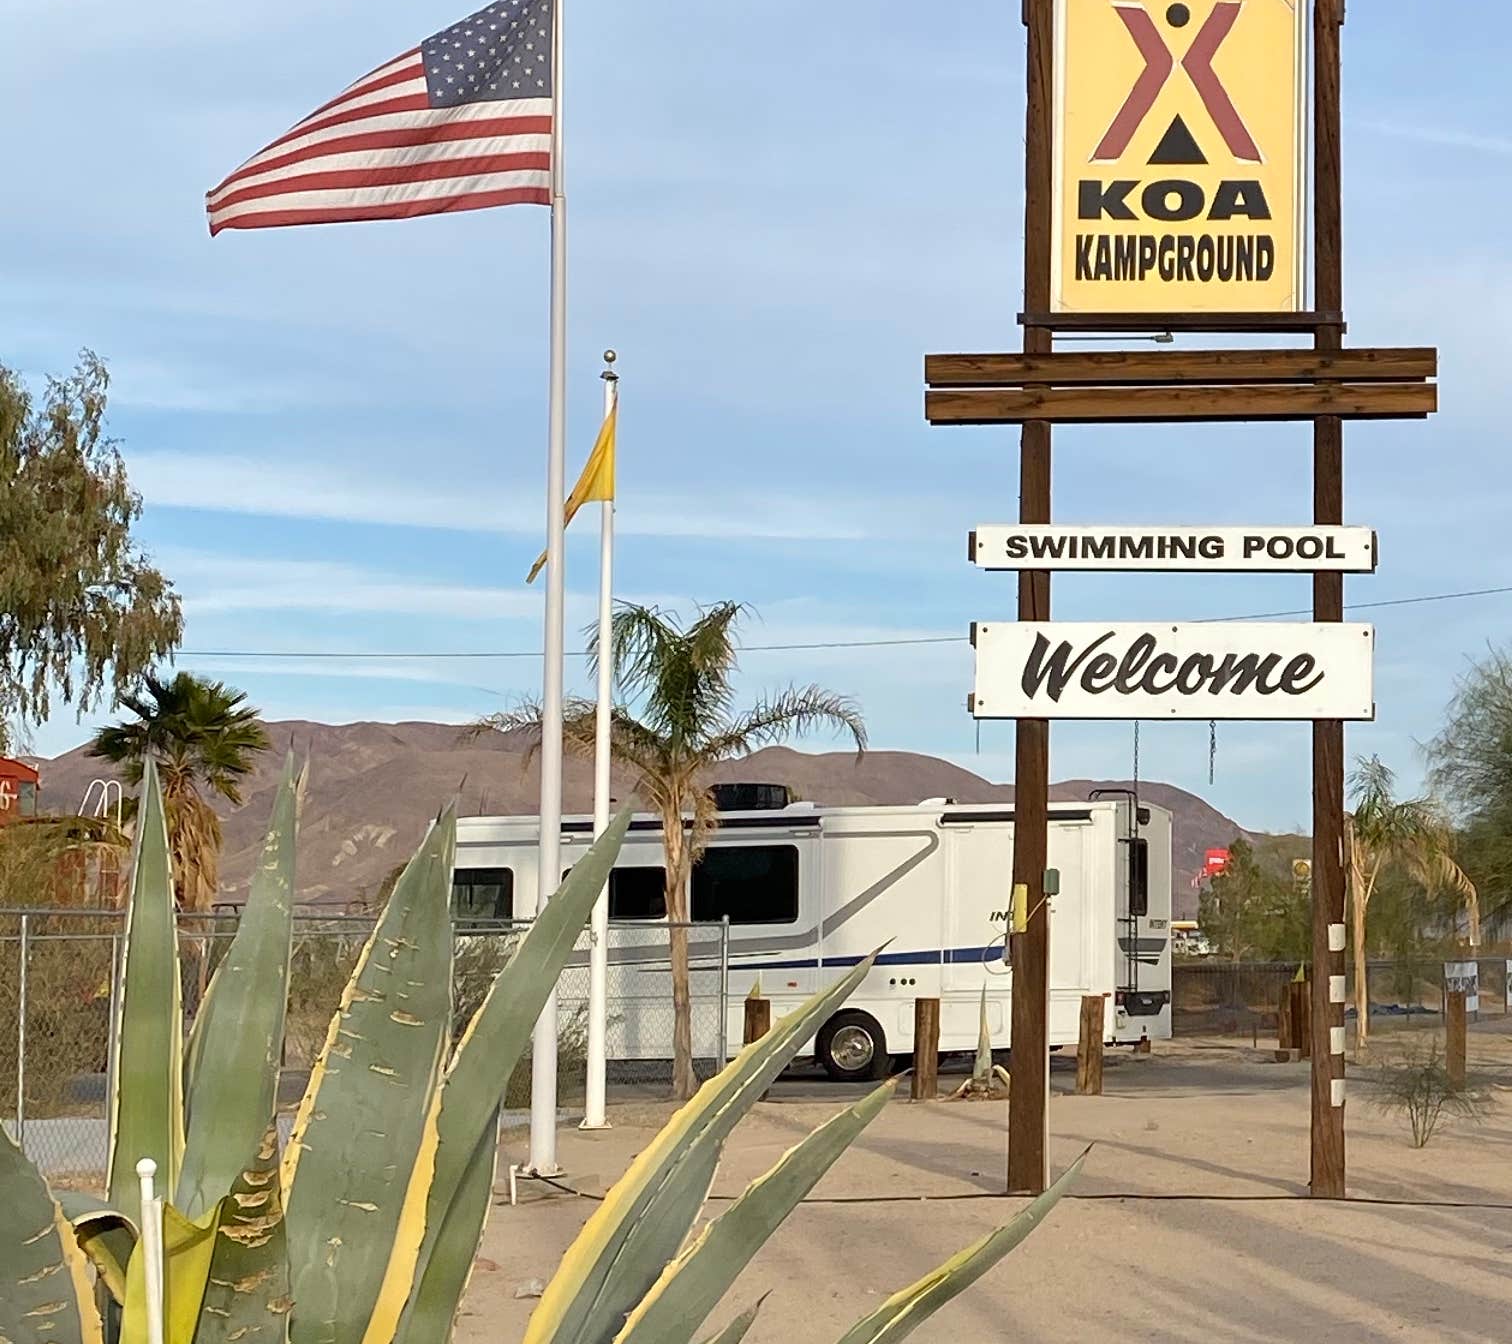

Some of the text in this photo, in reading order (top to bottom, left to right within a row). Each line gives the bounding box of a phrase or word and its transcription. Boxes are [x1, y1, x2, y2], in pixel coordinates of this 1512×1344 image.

[1077, 179, 1272, 222] KOA
[1075, 234, 1275, 282] KAMPGROUND
[1005, 535, 1346, 560] SWIMMING POOL
[1021, 631, 1325, 702] Welcome
